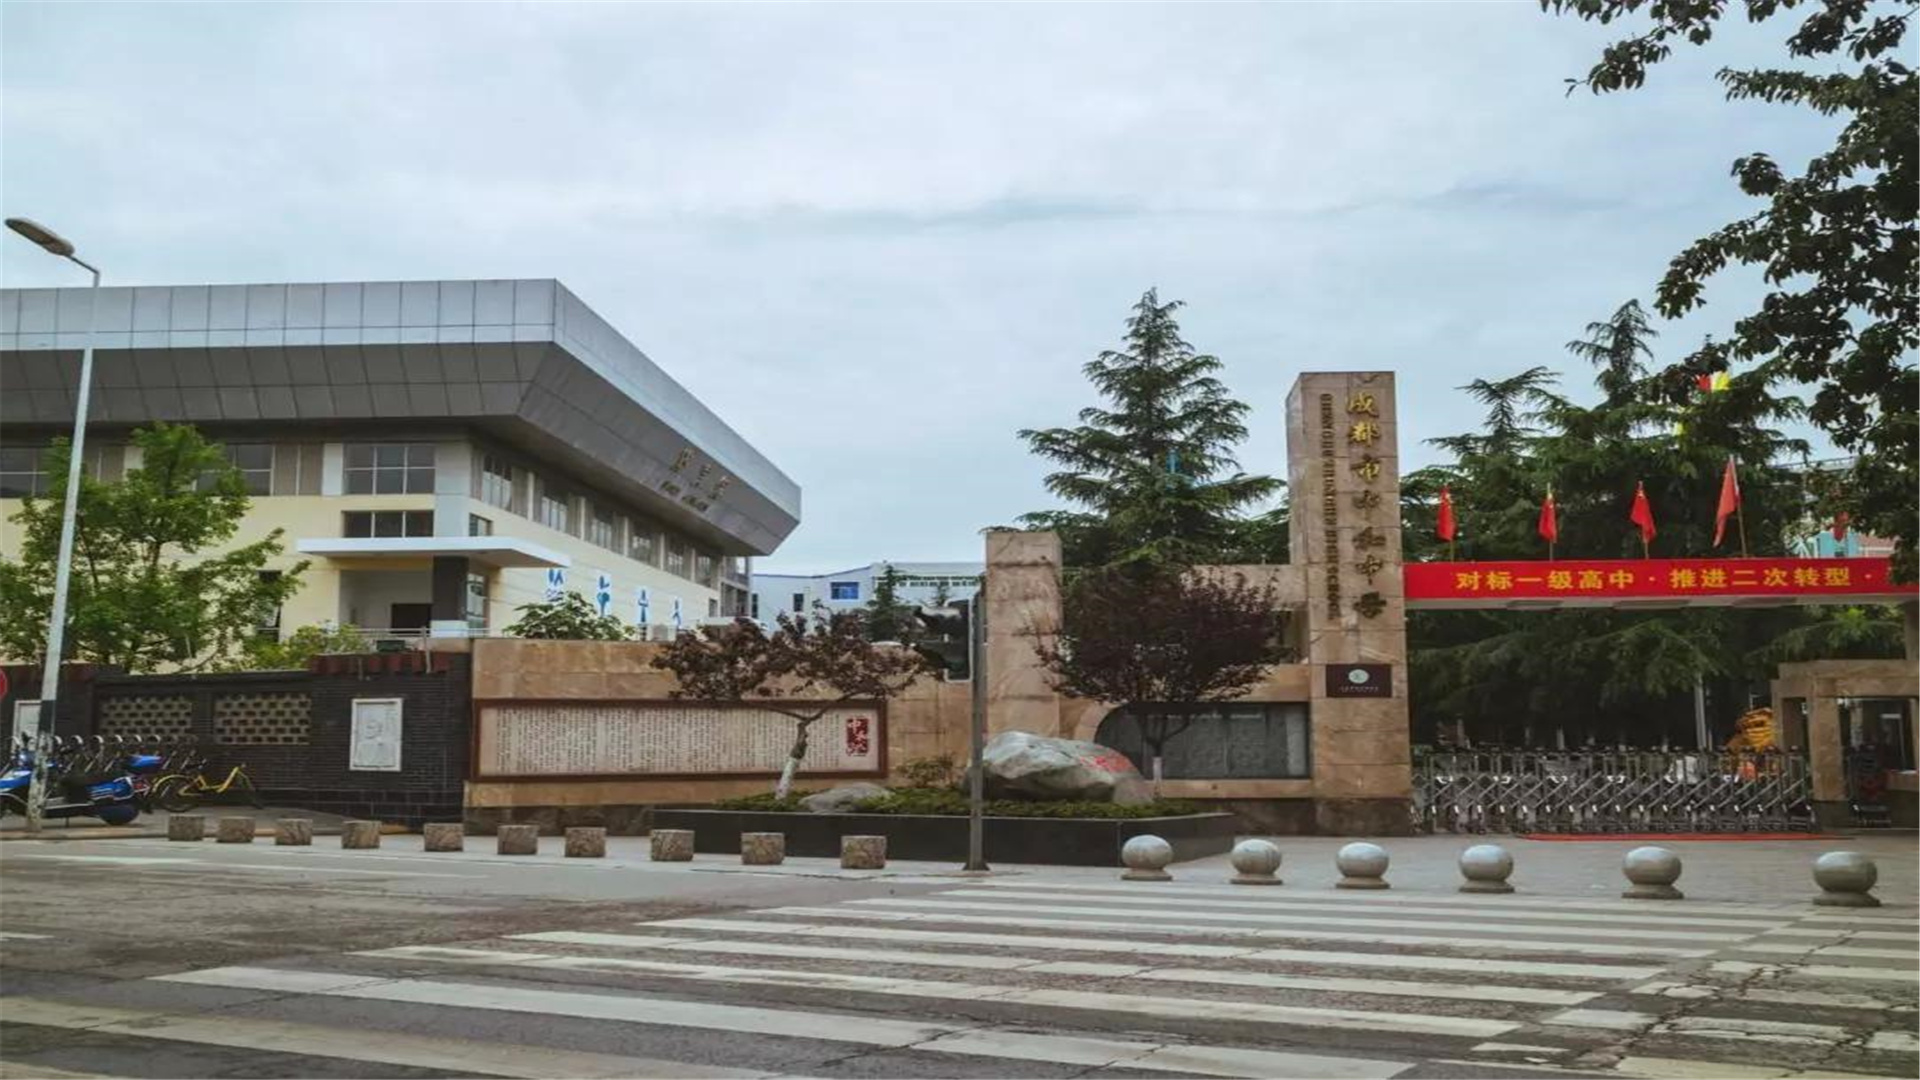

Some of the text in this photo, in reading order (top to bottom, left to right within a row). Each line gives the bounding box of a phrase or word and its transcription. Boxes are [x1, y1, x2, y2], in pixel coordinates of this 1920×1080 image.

[1347, 391, 1387, 619] 成都市中和中学
